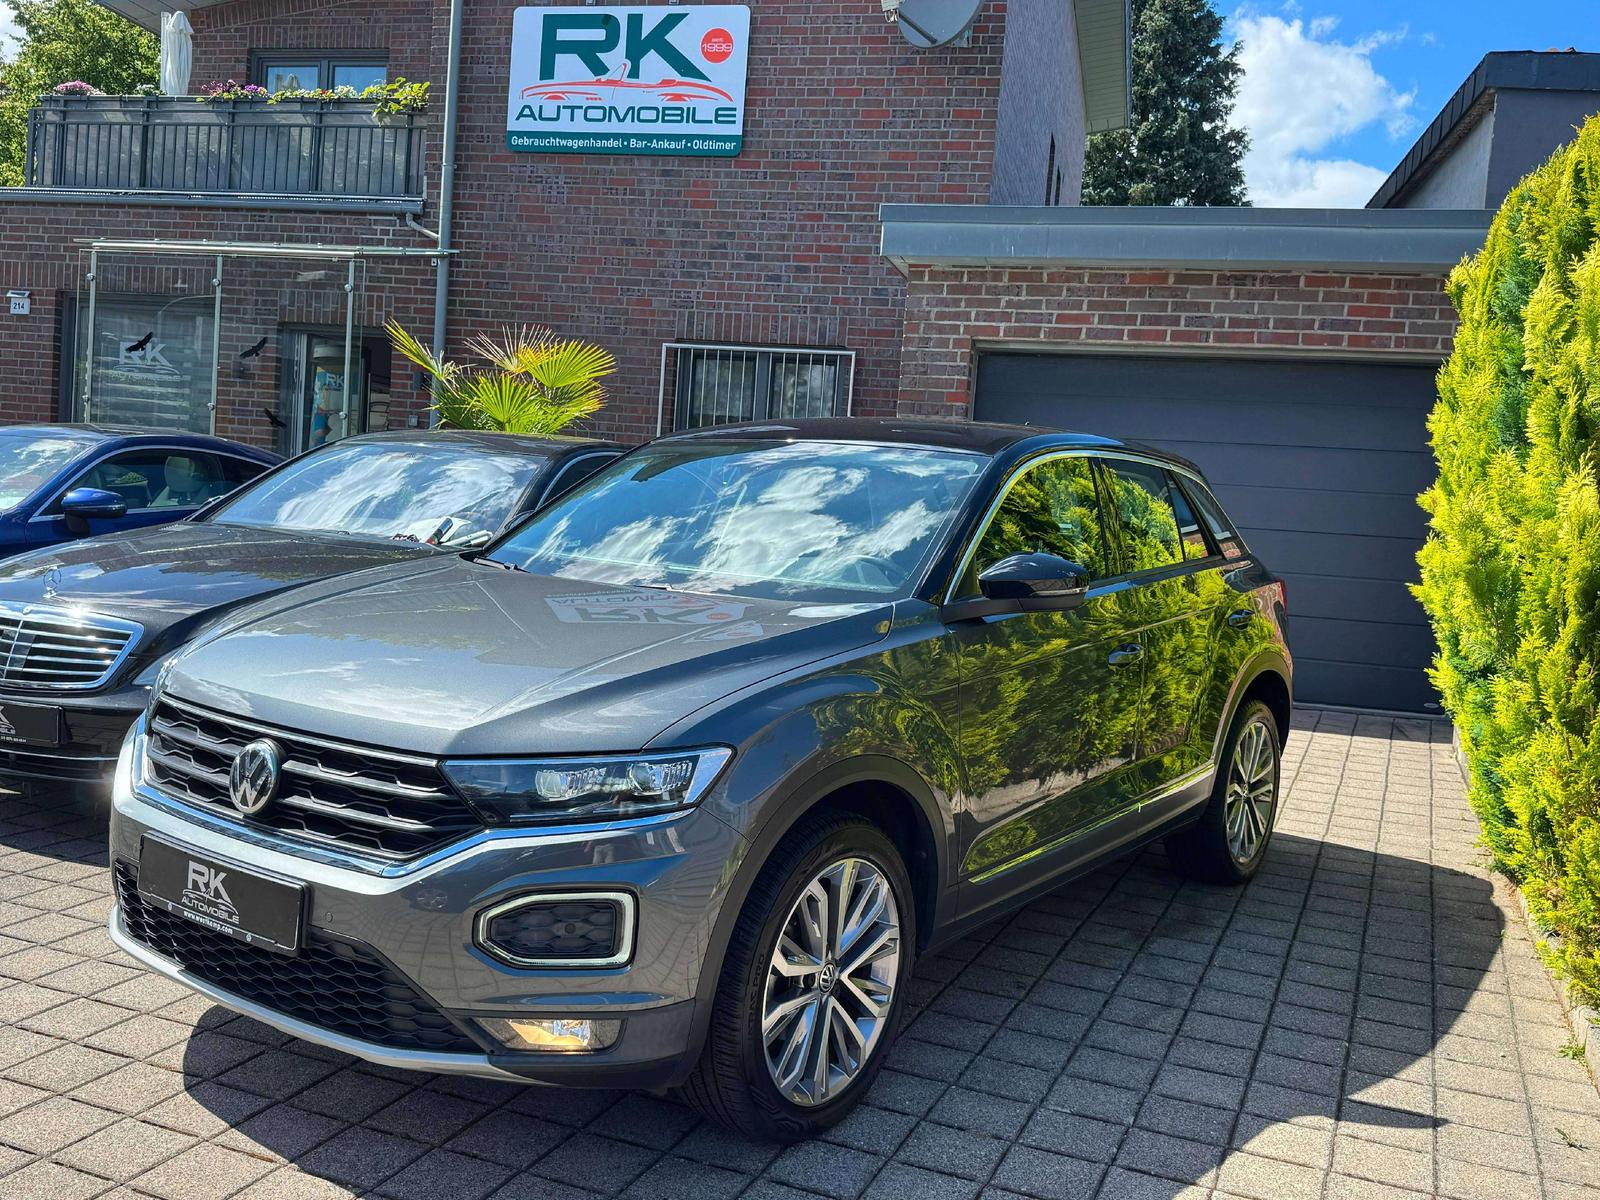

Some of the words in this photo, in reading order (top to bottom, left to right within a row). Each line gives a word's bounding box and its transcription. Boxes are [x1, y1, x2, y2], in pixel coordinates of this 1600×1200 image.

[539, 13, 713, 83] RK
[702, 43, 733, 52] 1999
[515, 104, 737, 125] AUTOMOBILE
[511, 136, 623, 149] Gebrauchtwagenhandel
[629, 138, 686, 150] Bar-Ankauf
[692, 139, 737, 150] Oldtimer
[13, 302, 25, 310] 214
[187, 860, 232, 905] RK
[181, 896, 240, 925] AUTOMOBILE
